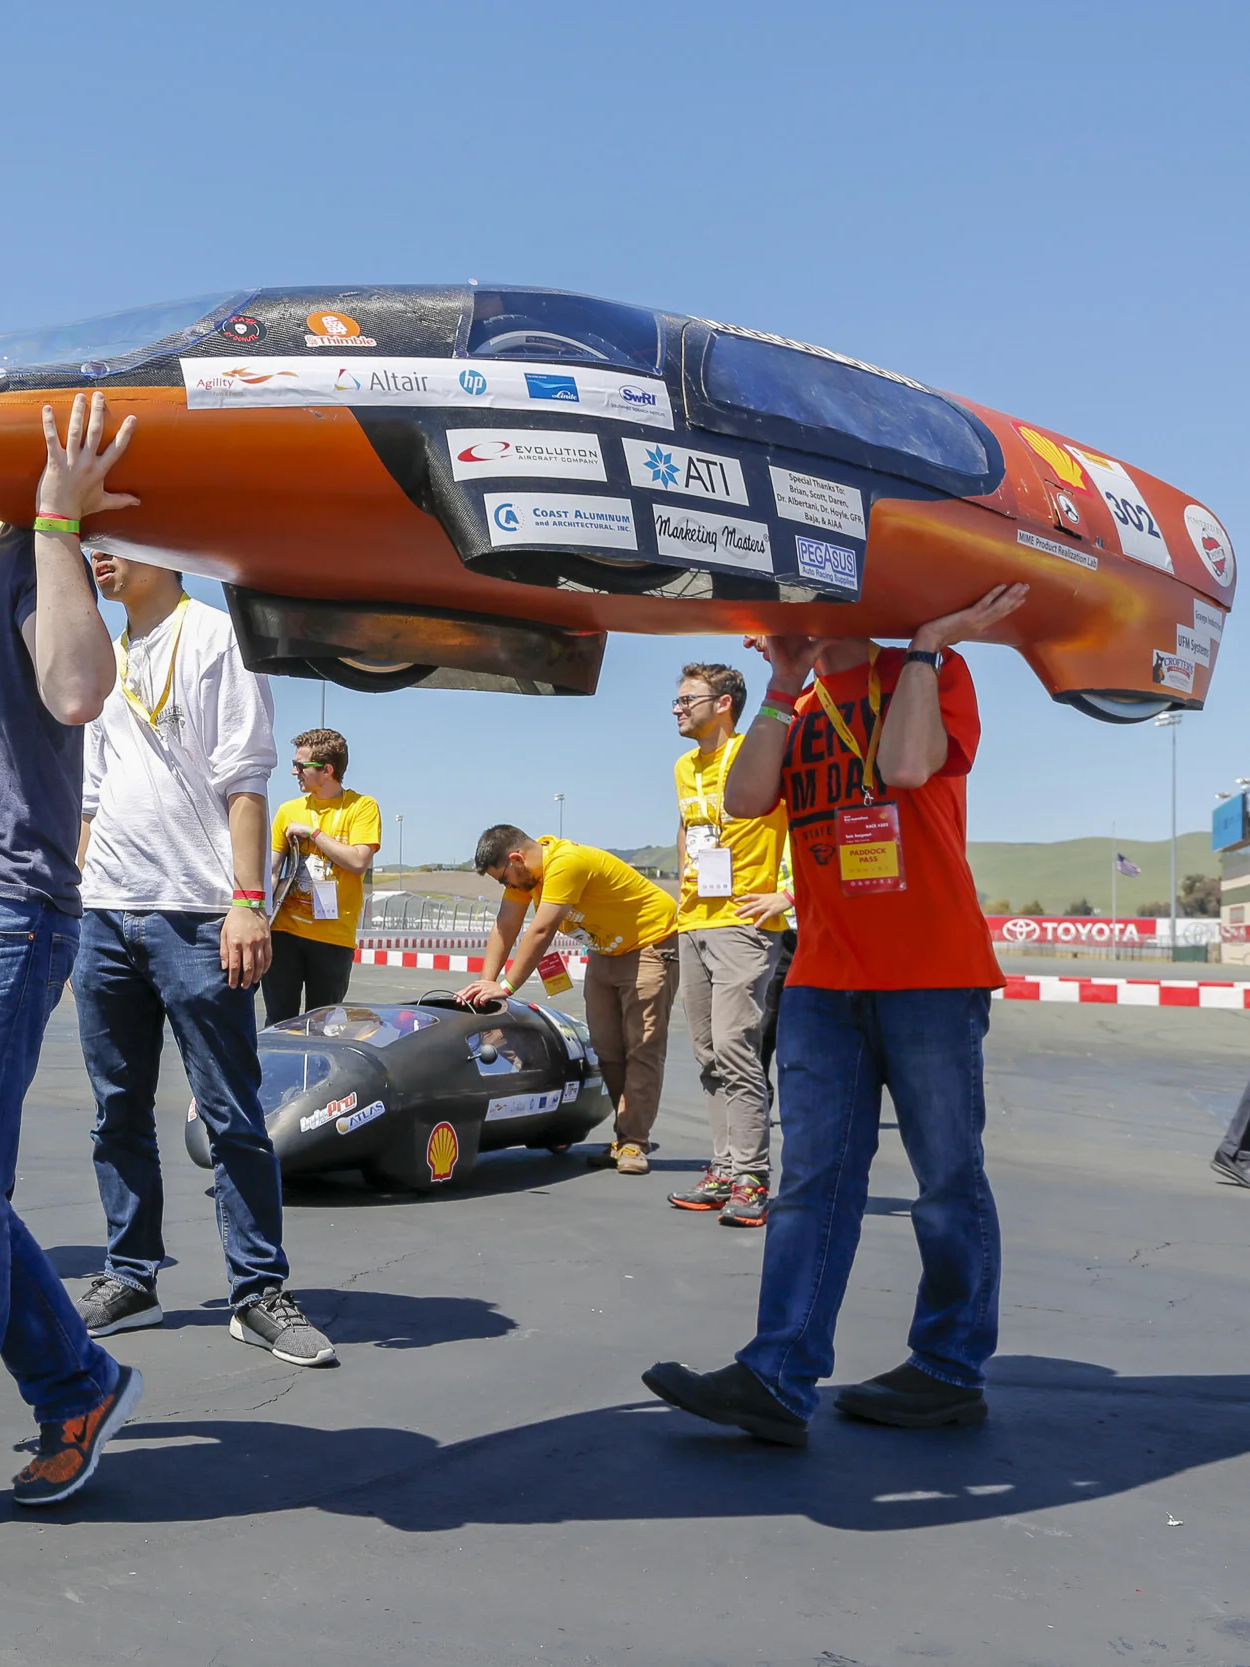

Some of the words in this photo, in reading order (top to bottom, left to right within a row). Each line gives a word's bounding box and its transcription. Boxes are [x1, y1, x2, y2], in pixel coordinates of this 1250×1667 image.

[318, 336, 374, 346] Thimble
[196, 378, 234, 390] Agility
[370, 370, 428, 392] Altair
[463, 369, 484, 395] hp
[552, 390, 578, 400] Linde
[623, 388, 658, 406] SwRI
[515, 445, 598, 458] EVOLUTION
[561, 457, 599, 465] COMPANY
[684, 456, 731, 497] ATI
[789, 473, 812, 486] Special
[812, 479, 836, 492] Thanks
[836, 487, 846, 495] To:
[777, 493, 787, 503] Dr.
[820, 505, 830, 514] Dr.
[830, 508, 850, 520] Hoyle,
[789, 485, 809, 497] Brian,
[810, 490, 828, 502] Scott,
[828, 495, 849, 508] Daren,
[533, 508, 569, 518] COAST
[574, 509, 631, 523] ALUMINUM
[1105, 491, 1161, 540] 302
[656, 514, 717, 552] Marketing
[722, 525, 765, 554] Masters
[800, 542, 854, 573] PEGASUS
[1019, 532, 1034, 545] MIME
[1035, 538, 1058, 553] Product
[1058, 545, 1087, 564] Realization
[1087, 557, 1097, 568] Lab
[802, 566, 815, 576] Auto
[815, 569, 833, 582] Racing
[834, 573, 855, 587] Supplies
[1178, 634, 1191, 650] UFM
[827, 756, 887, 804] DAY
[850, 847, 887, 857] PADDOCK
[1042, 922, 1139, 942] TOYOTA
[350, 1102, 383, 1126] ATLAS
